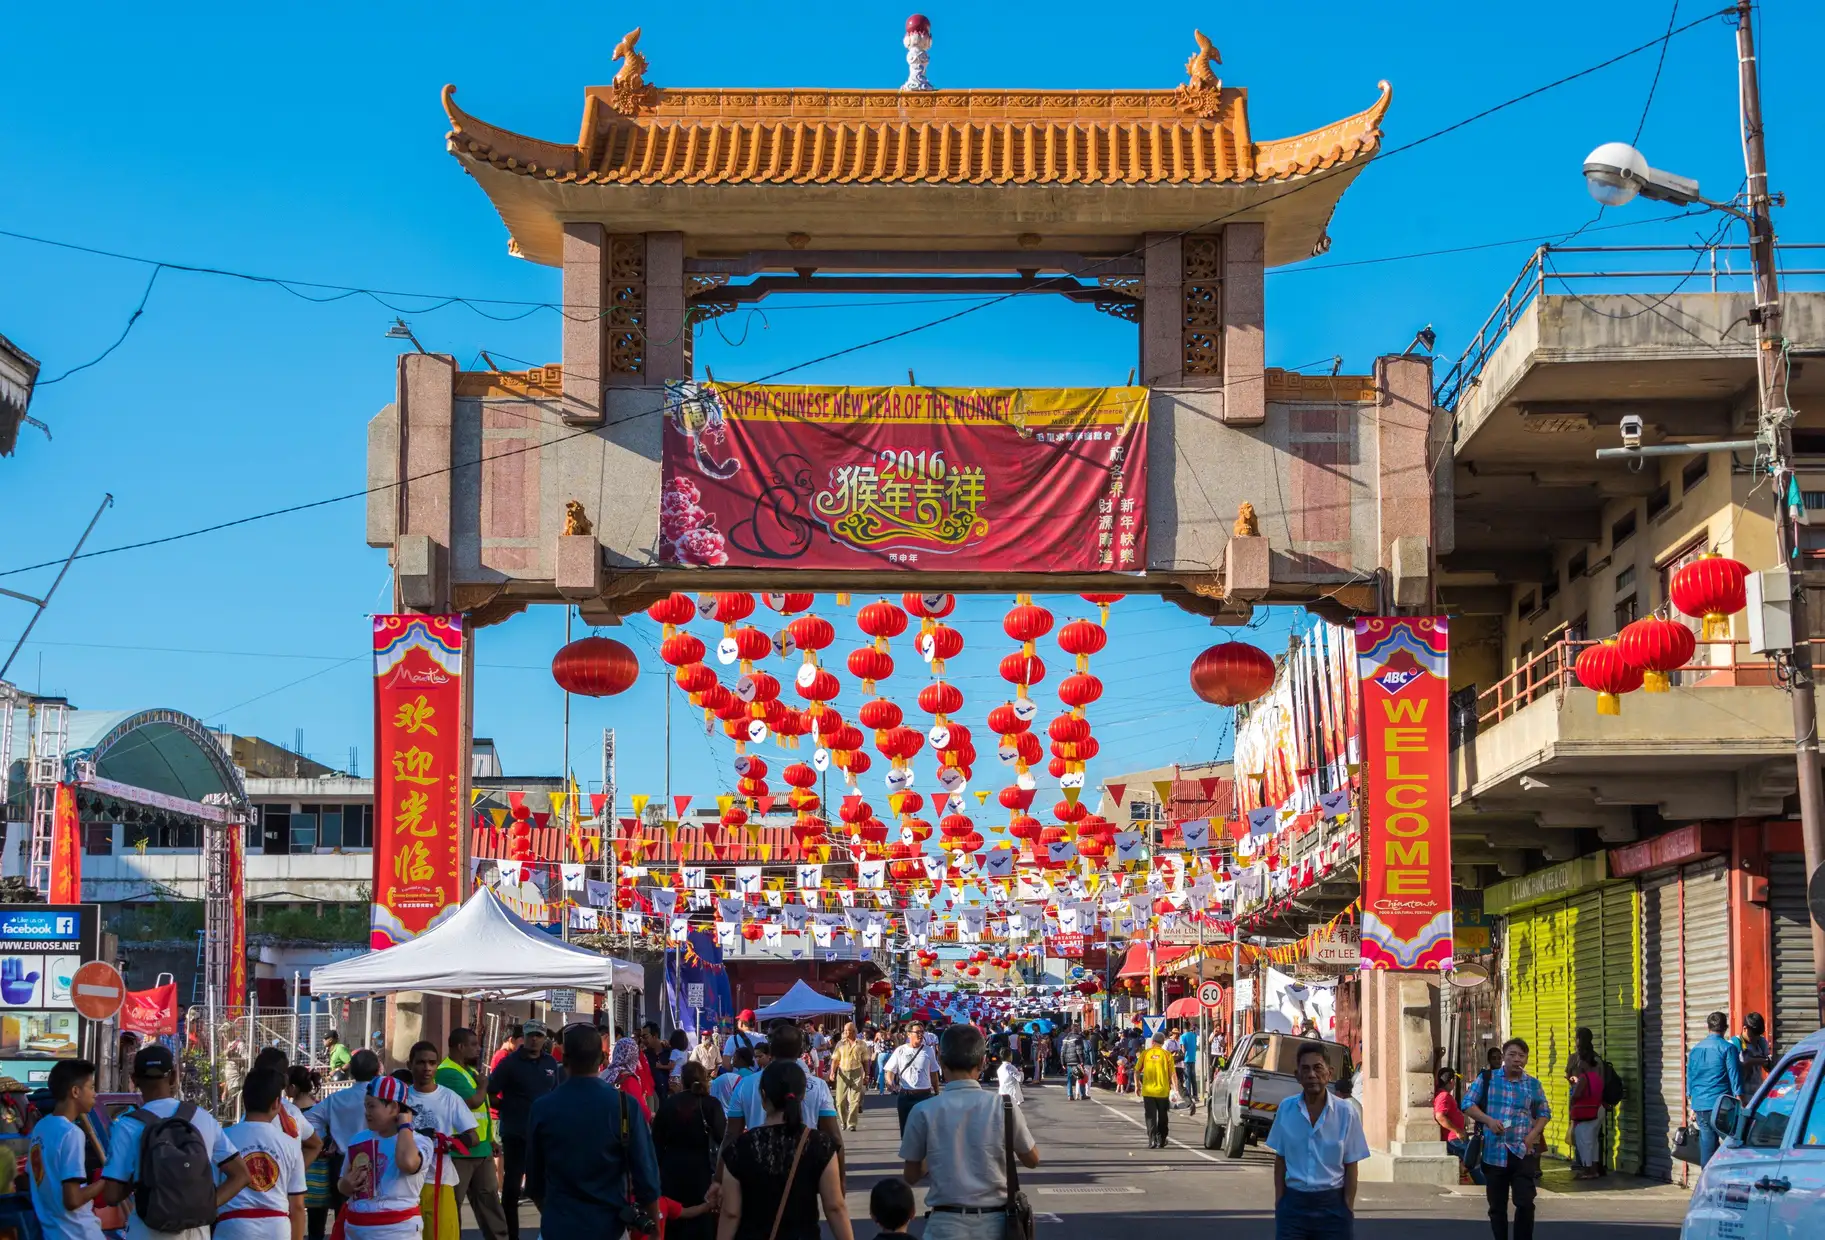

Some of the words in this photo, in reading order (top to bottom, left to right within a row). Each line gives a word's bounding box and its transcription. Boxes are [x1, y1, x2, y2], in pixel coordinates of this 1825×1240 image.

[725, 390, 770, 416] HAPPY
[774, 392, 830, 418] CHINESE
[833, 393, 864, 418] NEW
[867, 394, 900, 418] YEAR
[904, 394, 922, 418] OF
[925, 394, 951, 419] THE
[954, 395, 1011, 420] MONKEY
[1027, 409, 1051, 417] Chinese
[880, 449, 946, 480] 2016
[1109, 446, 1125, 498] 祝各界
[818, 465, 986, 524] 猴年吉祥
[1098, 498, 1113, 564] 財源廣進
[1120, 498, 1135, 563] 新年快樂
[888, 553, 918, 563] 丙申年
[1382, 671, 1409, 684] ABC
[391, 694, 440, 885] 欢迎光临
[1382, 698, 1431, 895] WELCOME
[1373, 899, 1438, 910] Chinatown
[2, 923, 52, 934] facebook
[1318, 949, 1335, 958] KIM
[1338, 949, 1355, 958] LEE
[1202, 988, 1218, 1001] 60
